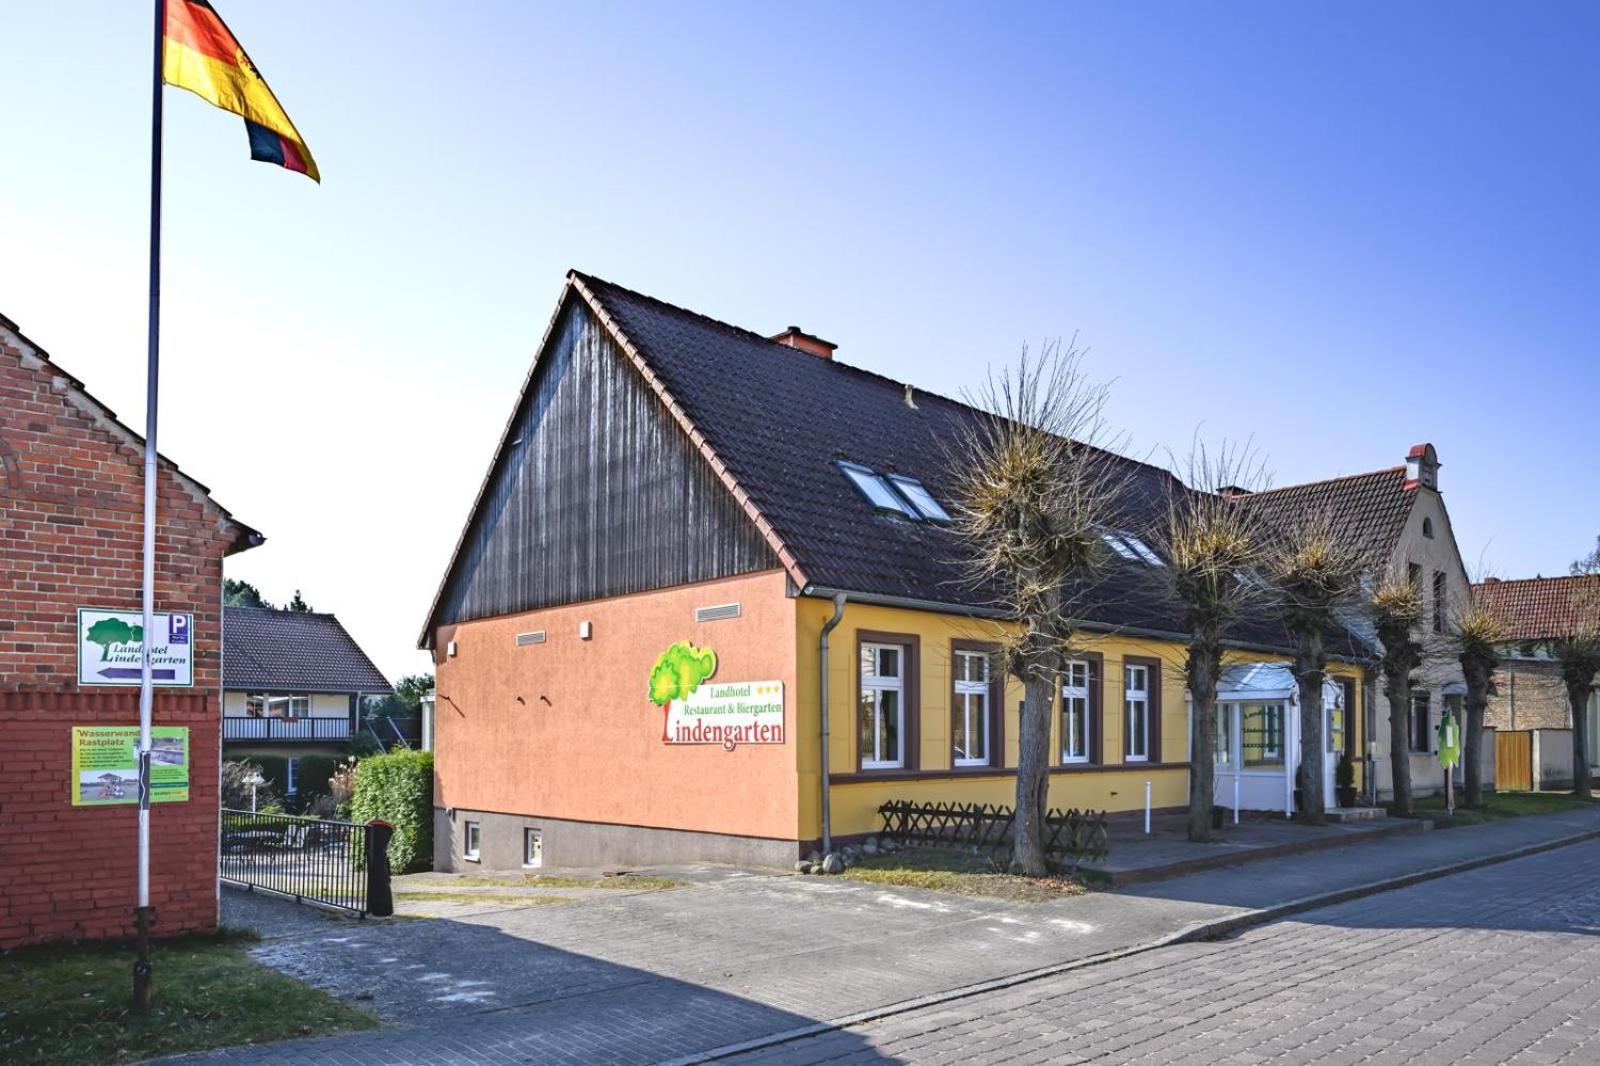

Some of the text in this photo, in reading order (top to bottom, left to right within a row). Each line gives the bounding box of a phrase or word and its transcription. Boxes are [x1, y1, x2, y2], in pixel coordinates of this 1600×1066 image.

[172, 615, 186, 634] P
[100, 646, 186, 665] Lindegarten
[710, 685, 751, 699] Landhotel
[684, 702, 782, 717] Restaurant & Biergarten
[662, 703, 782, 750] Lindengarten
[79, 738, 125, 747] Rastplatz
